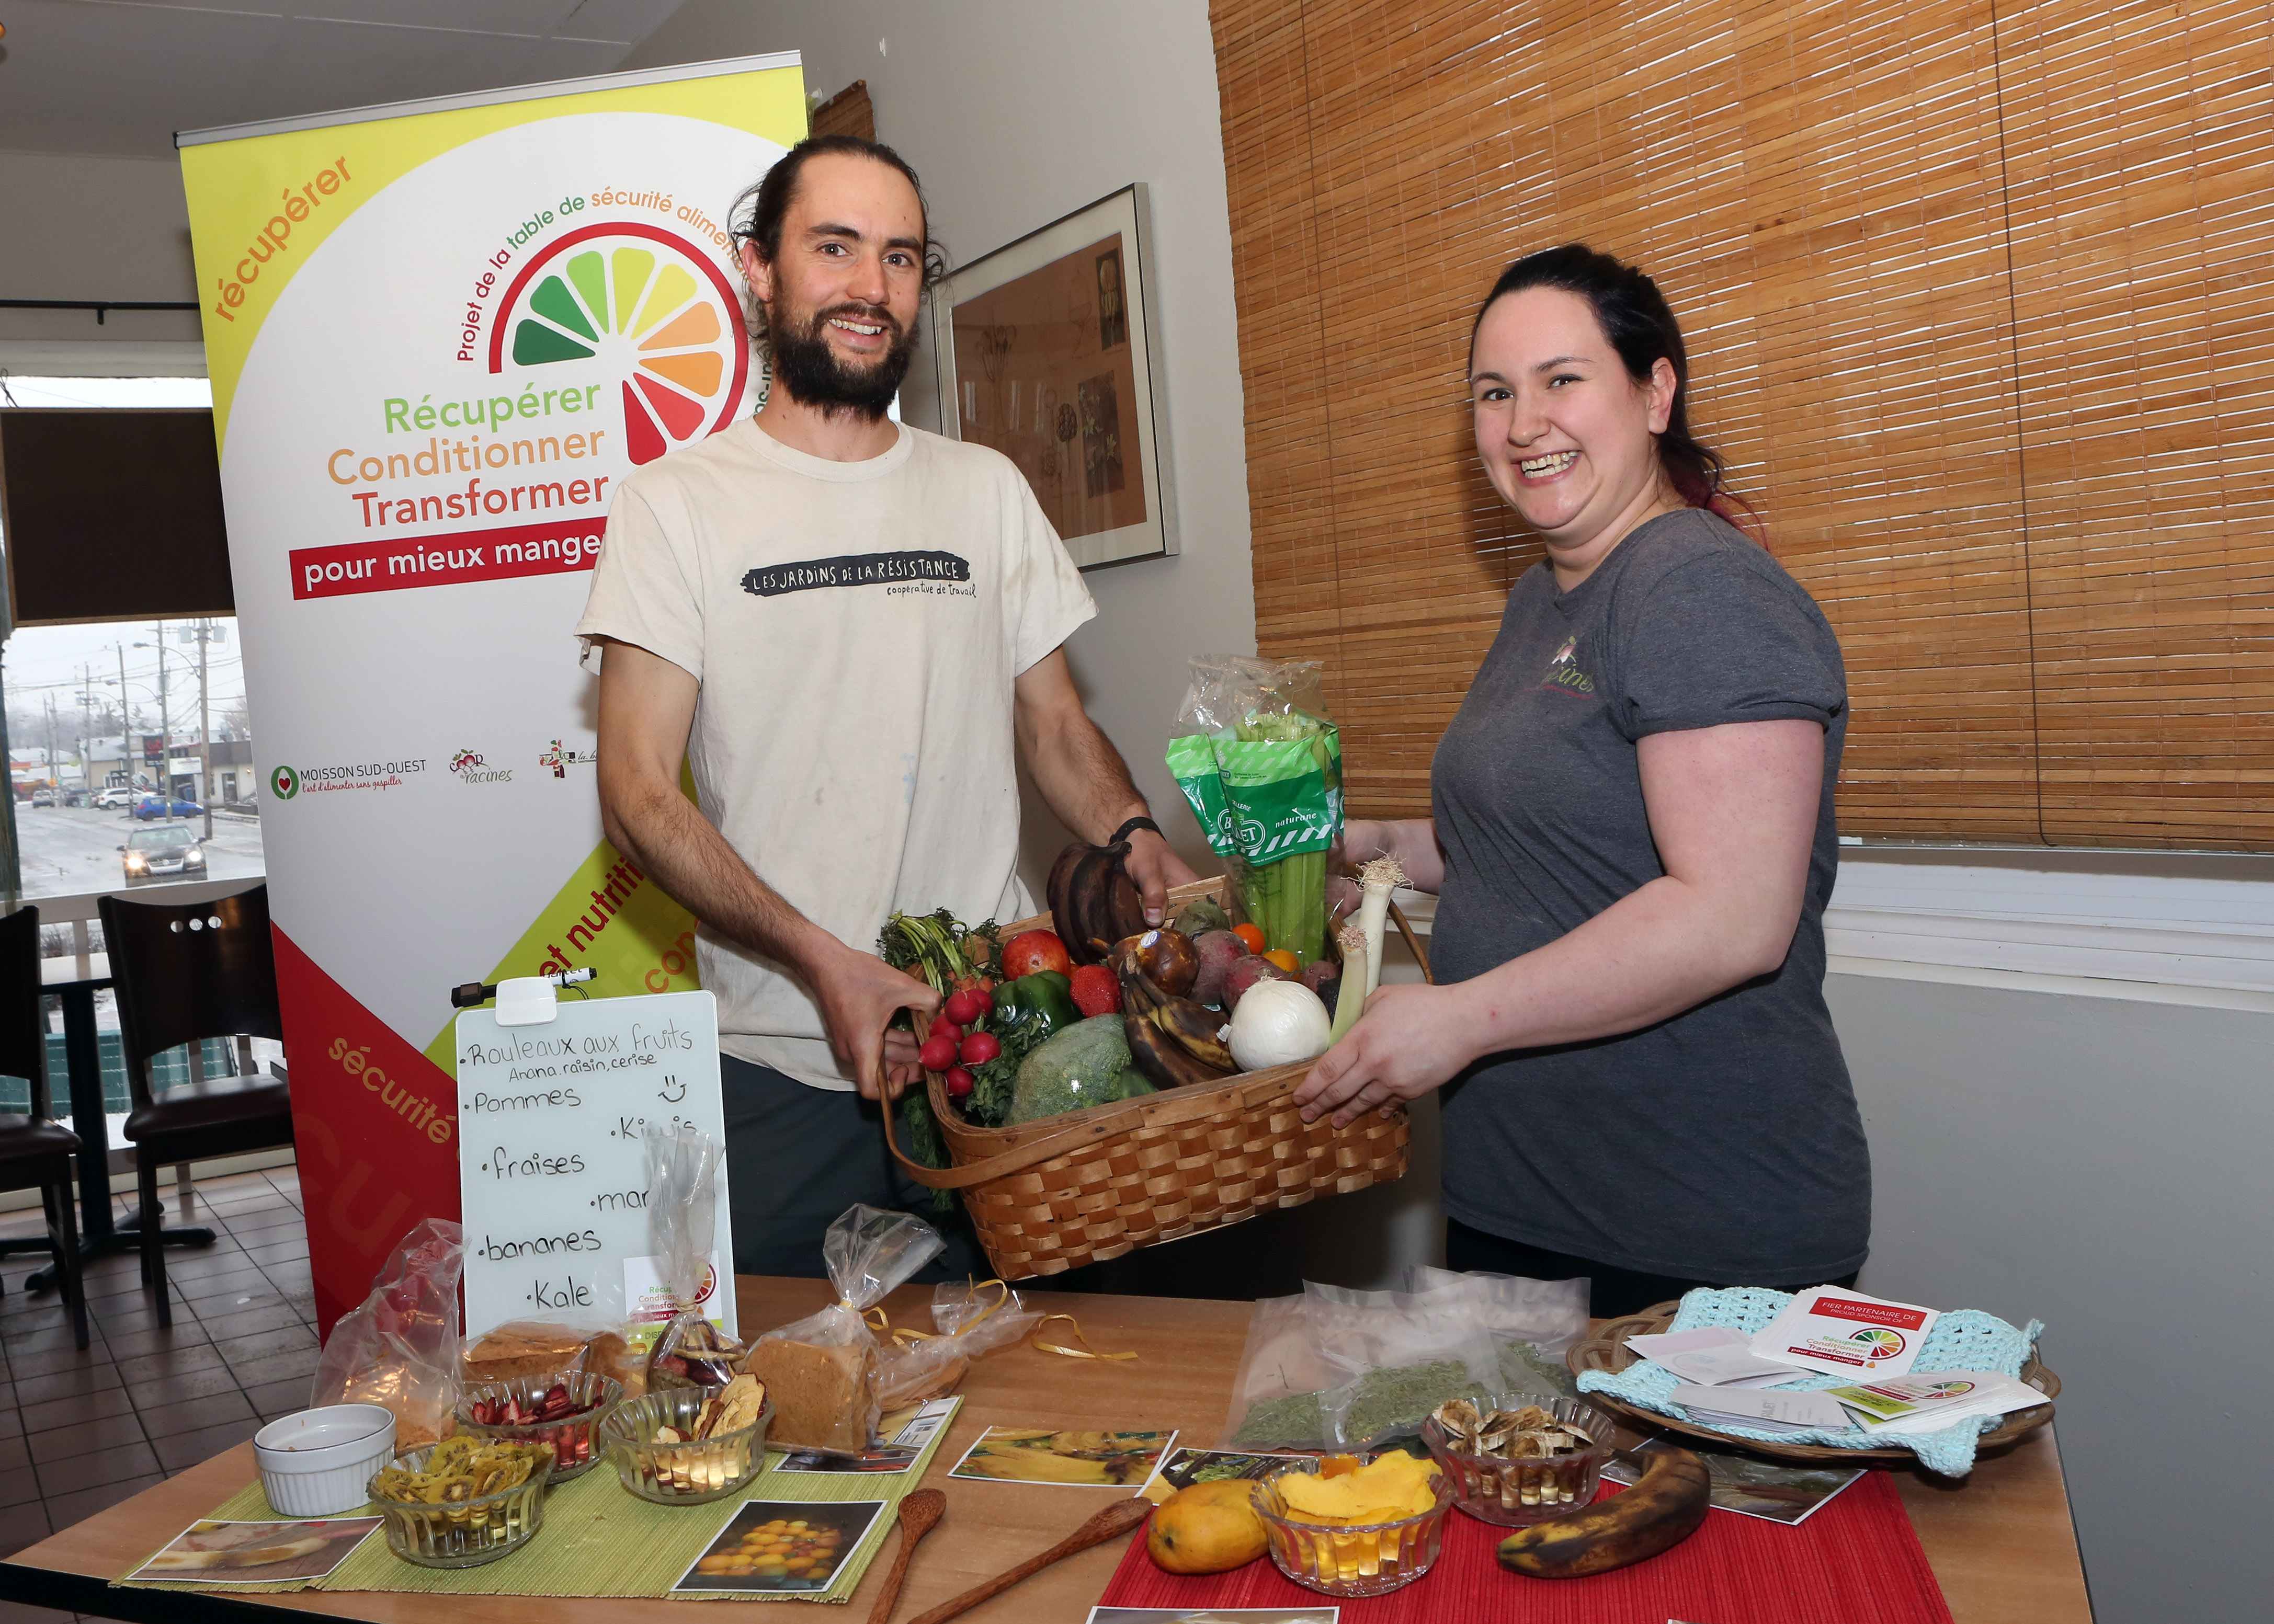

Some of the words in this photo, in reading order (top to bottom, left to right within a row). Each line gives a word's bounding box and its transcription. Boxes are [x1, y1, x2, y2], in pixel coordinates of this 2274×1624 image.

[215, 155, 352, 322] récupérer
[457, 302, 482, 362] Projet
[475, 272, 496, 299] de
[488, 250, 510, 272] la
[507, 211, 554, 251] table
[559, 196, 585, 216] de
[592, 186, 672, 213] sécurité
[384, 382, 600, 433] Récupérer
[328, 430, 605, 485] Conditionner
[353, 476, 609, 527] Transformer
[304, 555, 376, 591] pour
[388, 545, 485, 575] mieux
[495, 532, 604, 565] mange
[753, 575, 777, 590] LES
[842, 569, 852, 581] DE
[858, 566, 873, 580] LA
[887, 580, 934, 598] coopérative
[937, 584, 946, 594] de
[948, 584, 976, 599] travail
[301, 766, 354, 781] MOISSON
[357, 759, 426, 776] SUD-OUEST
[302, 783, 316, 793] l'art
[318, 780, 355, 791] d'alimenter
[373, 775, 402, 791] gaspiller
[465, 768, 513, 784] racines
[539, 944, 572, 977] et
[566, 856, 645, 953] nutriti
[467, 1033, 576, 1066] Rouleaux
[584, 1034, 620, 1053] aux
[632, 1019, 693, 1050] fruits
[328, 1036, 457, 1143] sécurité
[474, 1088, 581, 1114] Pommes
[494, 1147, 585, 1180] fraises
[485, 1229, 602, 1262] bananes
[534, 1275, 594, 1310] Kale
[1845, 1305, 1901, 1318] PARTENAIRE
[1857, 1312, 1891, 1322] SPONSOR
[1806, 1339, 1868, 1354] Conditionner
[1809, 1344, 1864, 1359] Transformer
[1822, 1335, 1871, 1348] Récupérer
[1833, 1355, 1861, 1365] manger
